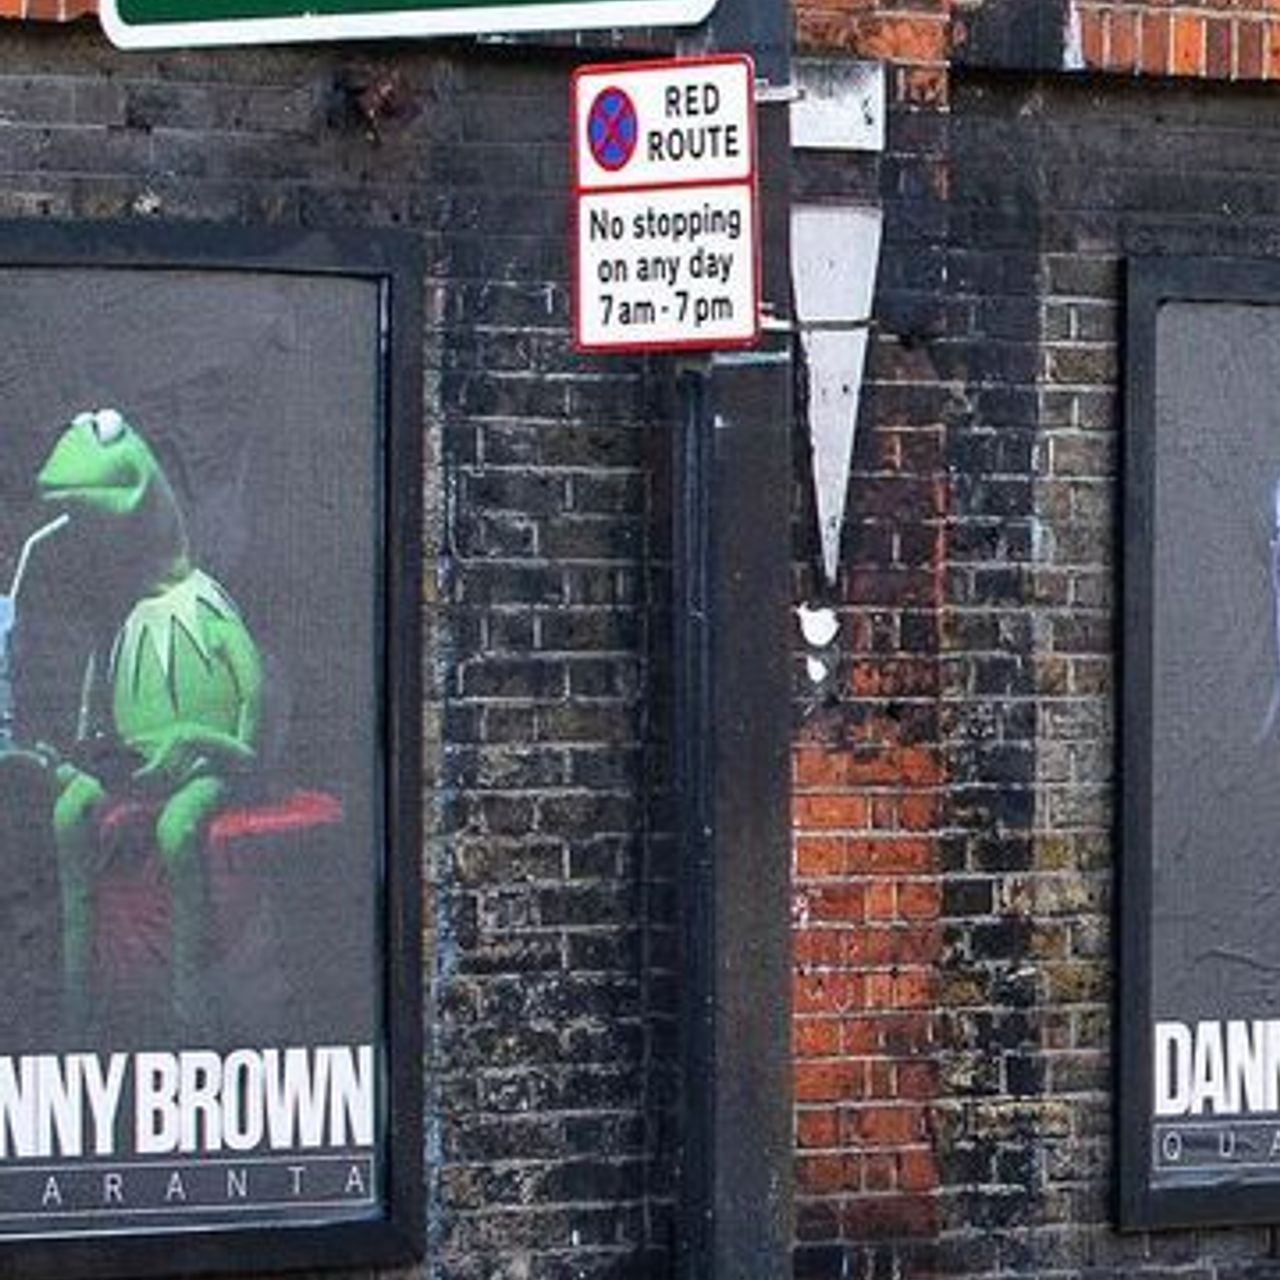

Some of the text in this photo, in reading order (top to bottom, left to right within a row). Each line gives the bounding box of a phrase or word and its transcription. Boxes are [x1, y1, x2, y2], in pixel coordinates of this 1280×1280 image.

[664, 83, 720, 117] RED
[647, 125, 740, 161] ROUTE
[589, 202, 741, 242] No stopping
[597, 246, 734, 287] on any day
[135, 1045, 374, 1154] BROWN
